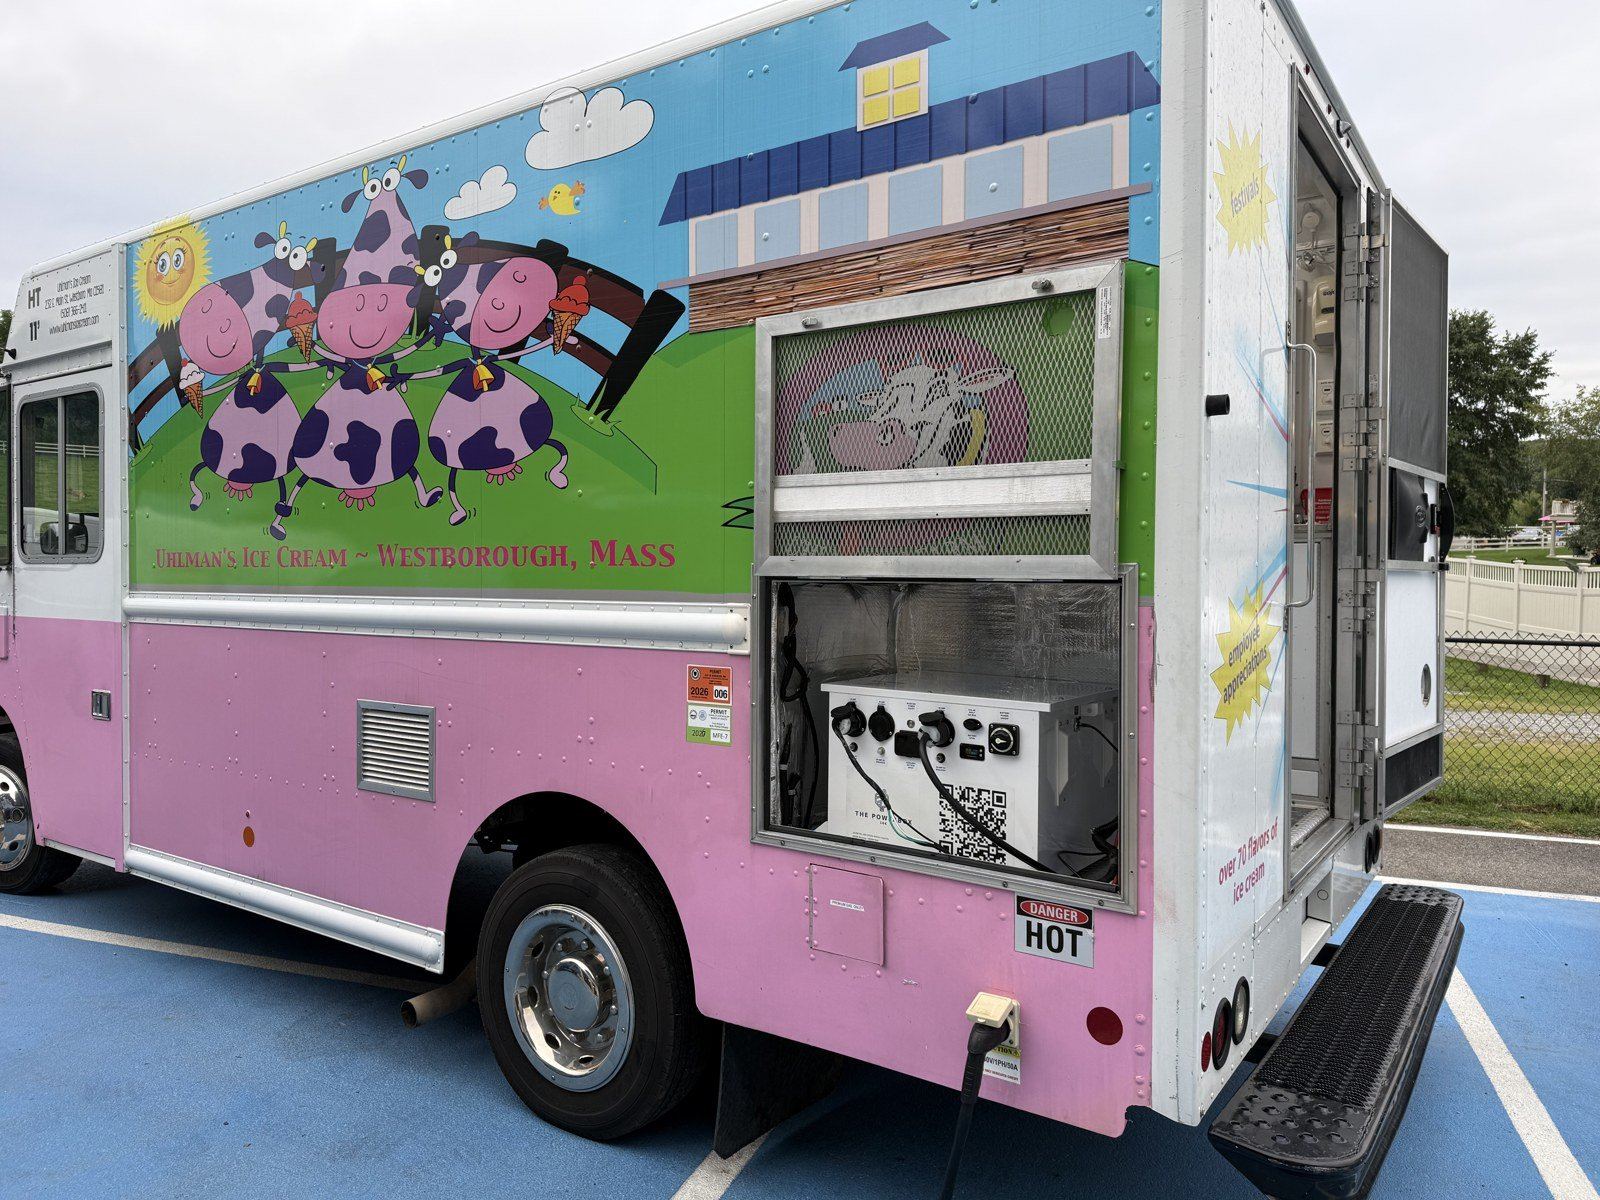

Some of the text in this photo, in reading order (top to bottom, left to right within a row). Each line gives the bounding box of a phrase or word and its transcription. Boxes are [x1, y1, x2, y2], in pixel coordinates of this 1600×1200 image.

[1231, 173, 1259, 218] festivals
[28, 287, 41, 309] HT
[156, 548, 236, 568] UHLMAN'S
[242, 546, 271, 568] ICE
[277, 545, 347, 568] CREAM
[377, 543, 577, 571] WESTBOROUGH,
[590, 540, 676, 568] MASS
[1228, 624, 1260, 667] employee
[690, 686, 709, 696] 2026
[1223, 645, 1267, 704] appreciations
[714, 689, 728, 699] 006
[854, 810, 868, 818] THE
[1219, 815, 1278, 885] over 70 flavors of
[1233, 862, 1265, 905] ice cream
[1030, 902, 1078, 923] DANGER
[1026, 920, 1083, 957] HOT
